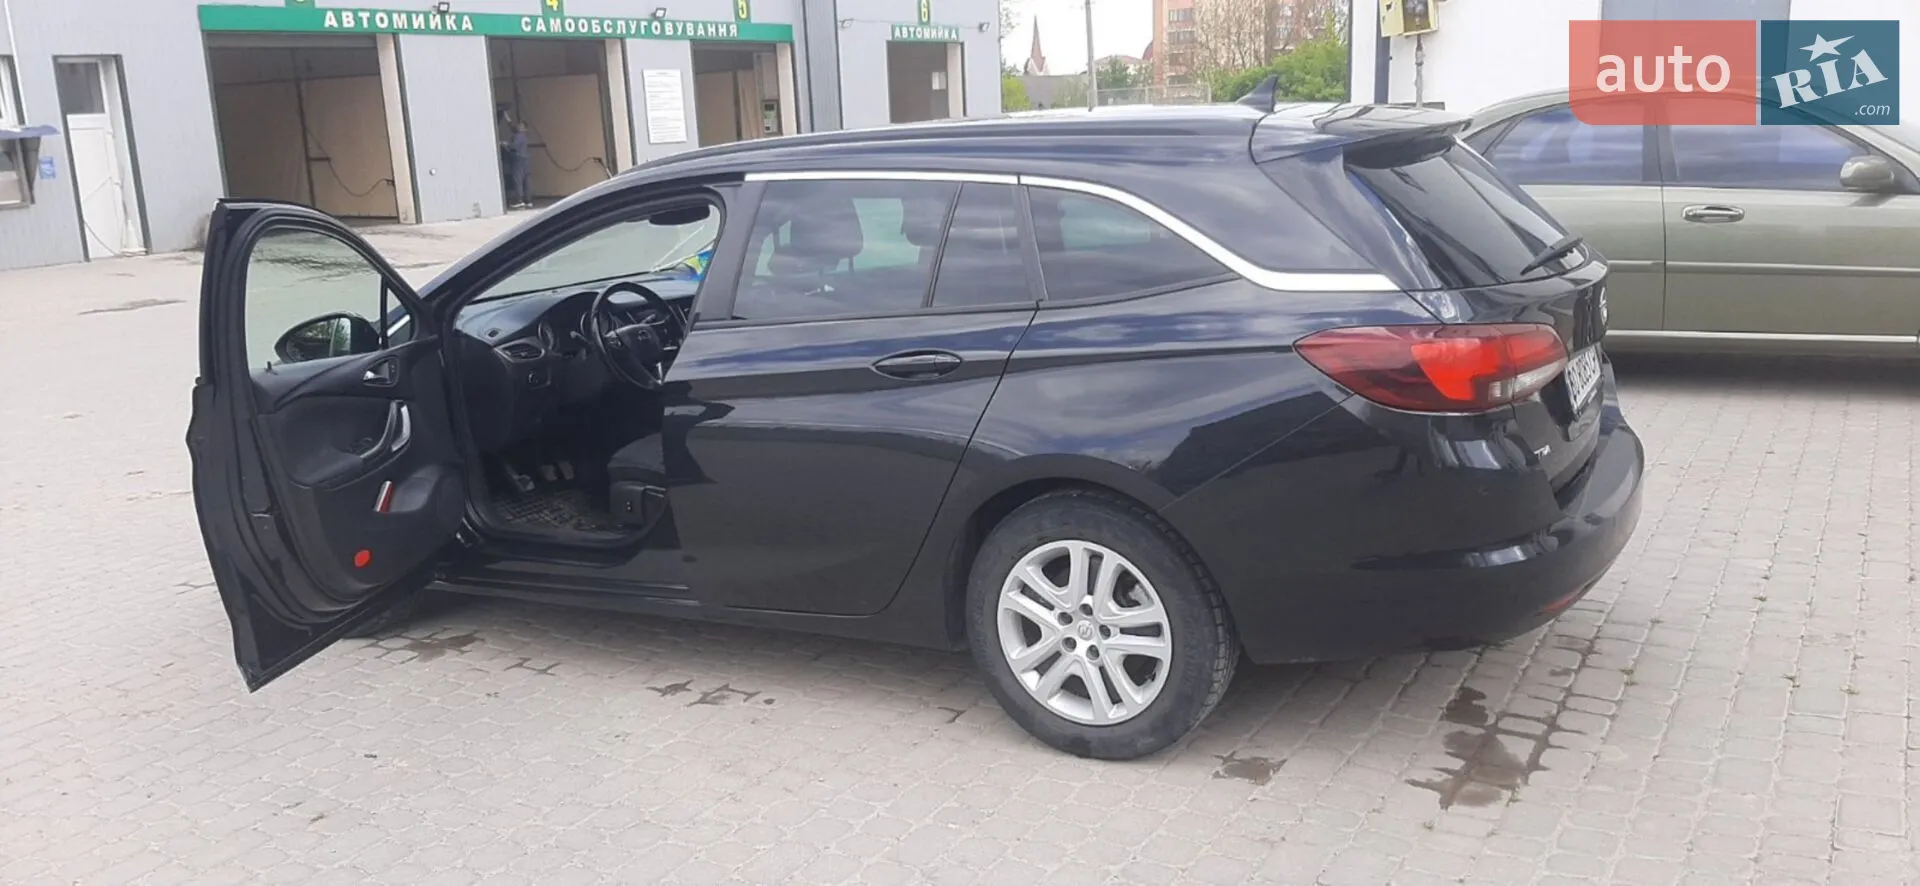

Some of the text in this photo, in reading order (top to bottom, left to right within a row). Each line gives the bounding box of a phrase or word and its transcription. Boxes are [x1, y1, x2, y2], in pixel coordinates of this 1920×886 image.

[920, 0, 929, 22] 6
[324, 10, 739, 38] АВТОМИЙКА САМООБСЛУГОВУВАННЯ
[894, 26, 958, 41] АВТОМИЙКА
